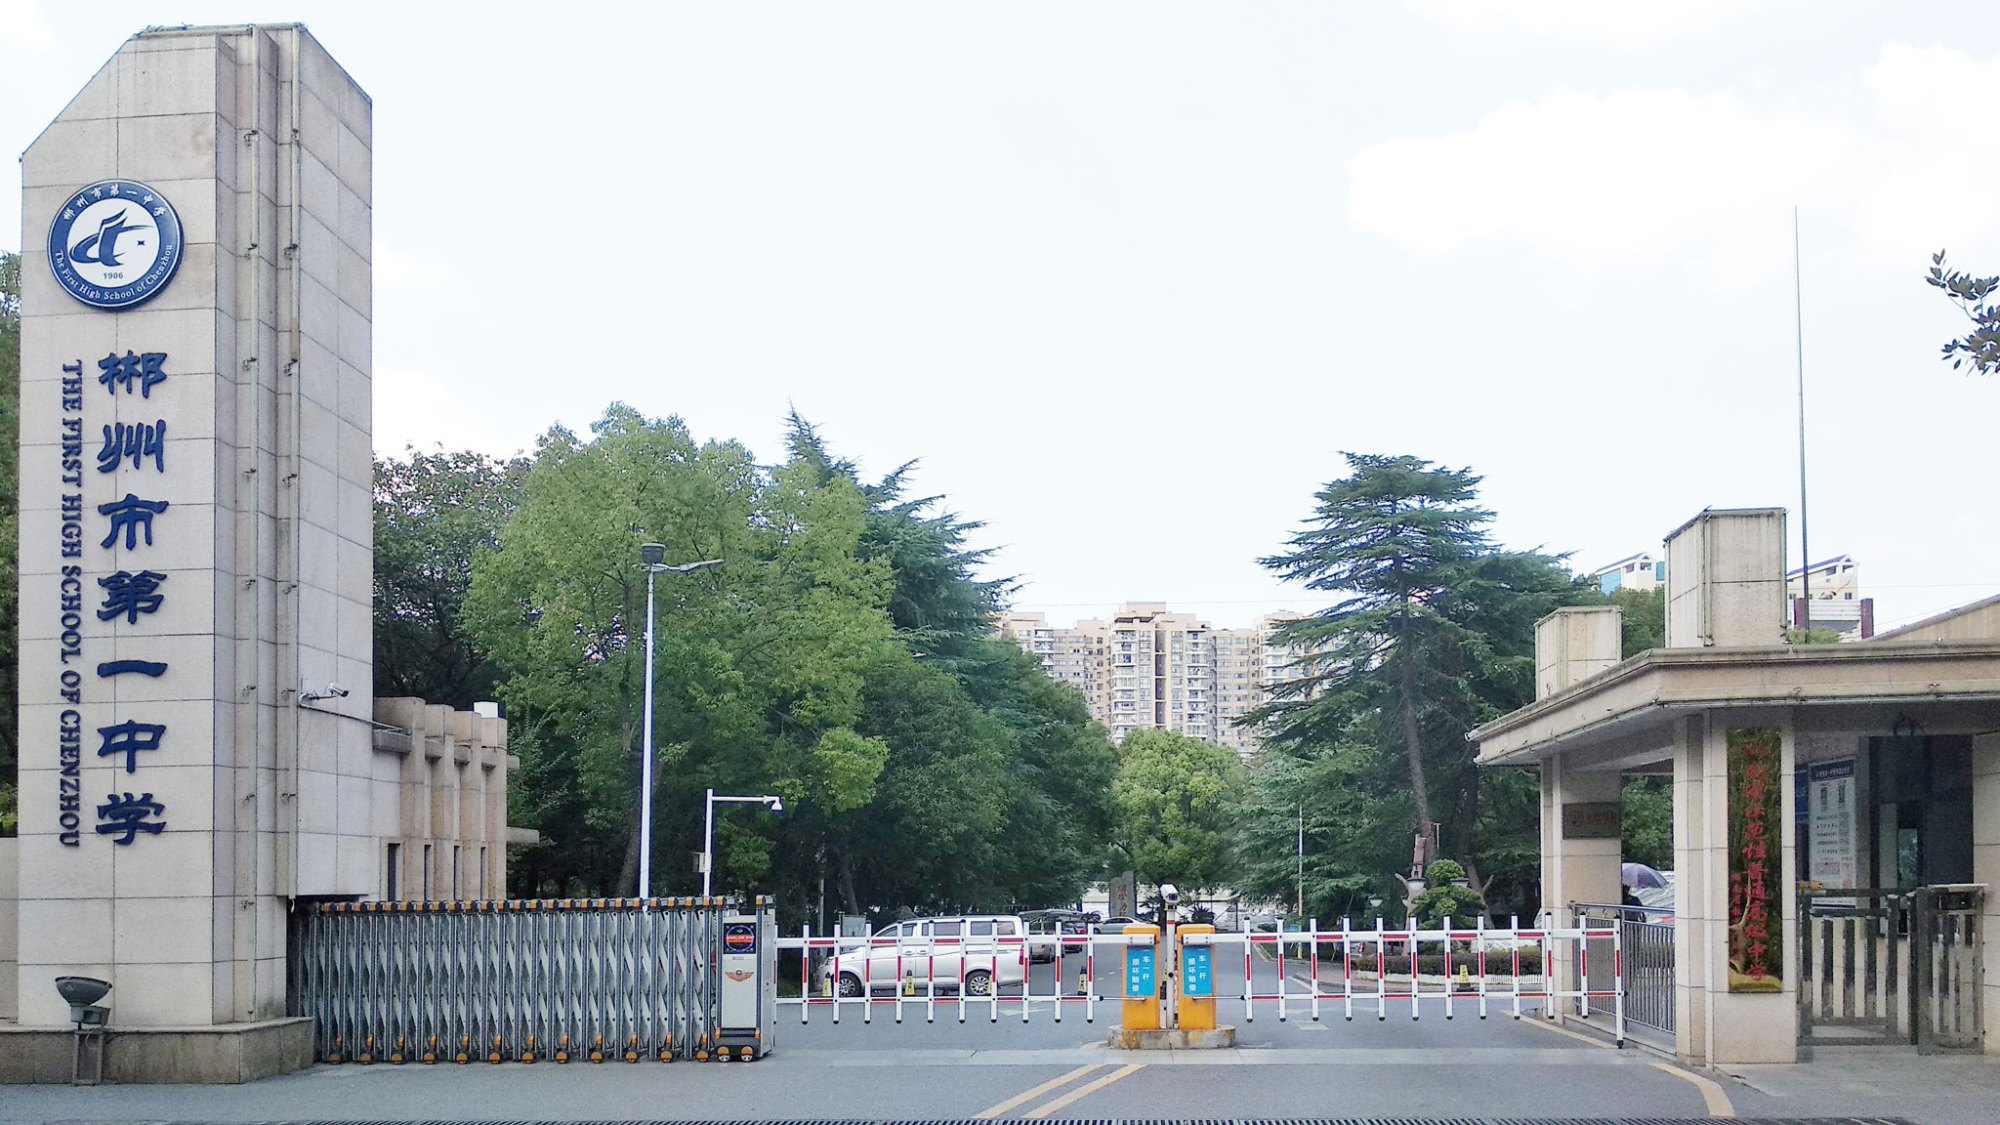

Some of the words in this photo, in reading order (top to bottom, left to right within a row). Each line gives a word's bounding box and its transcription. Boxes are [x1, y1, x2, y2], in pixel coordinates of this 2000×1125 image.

[55, 249, 65, 269] The
[61, 268, 79, 289] First
[78, 284, 102, 299] High
[103, 288, 135, 301] School
[136, 281, 146, 293] of
[145, 243, 173, 286] Chenzhou
[103, 271, 124, 280] 1906
[62, 359, 83, 411] THE
[62, 417, 83, 488] FIRST
[61, 494, 82, 558] HIGH
[61, 565, 82, 664] SCHOOL
[96, 350, 169, 846] 郴州市第一中学
[60, 670, 81, 704] OF
[59, 709, 81, 848] CHENZHOU
